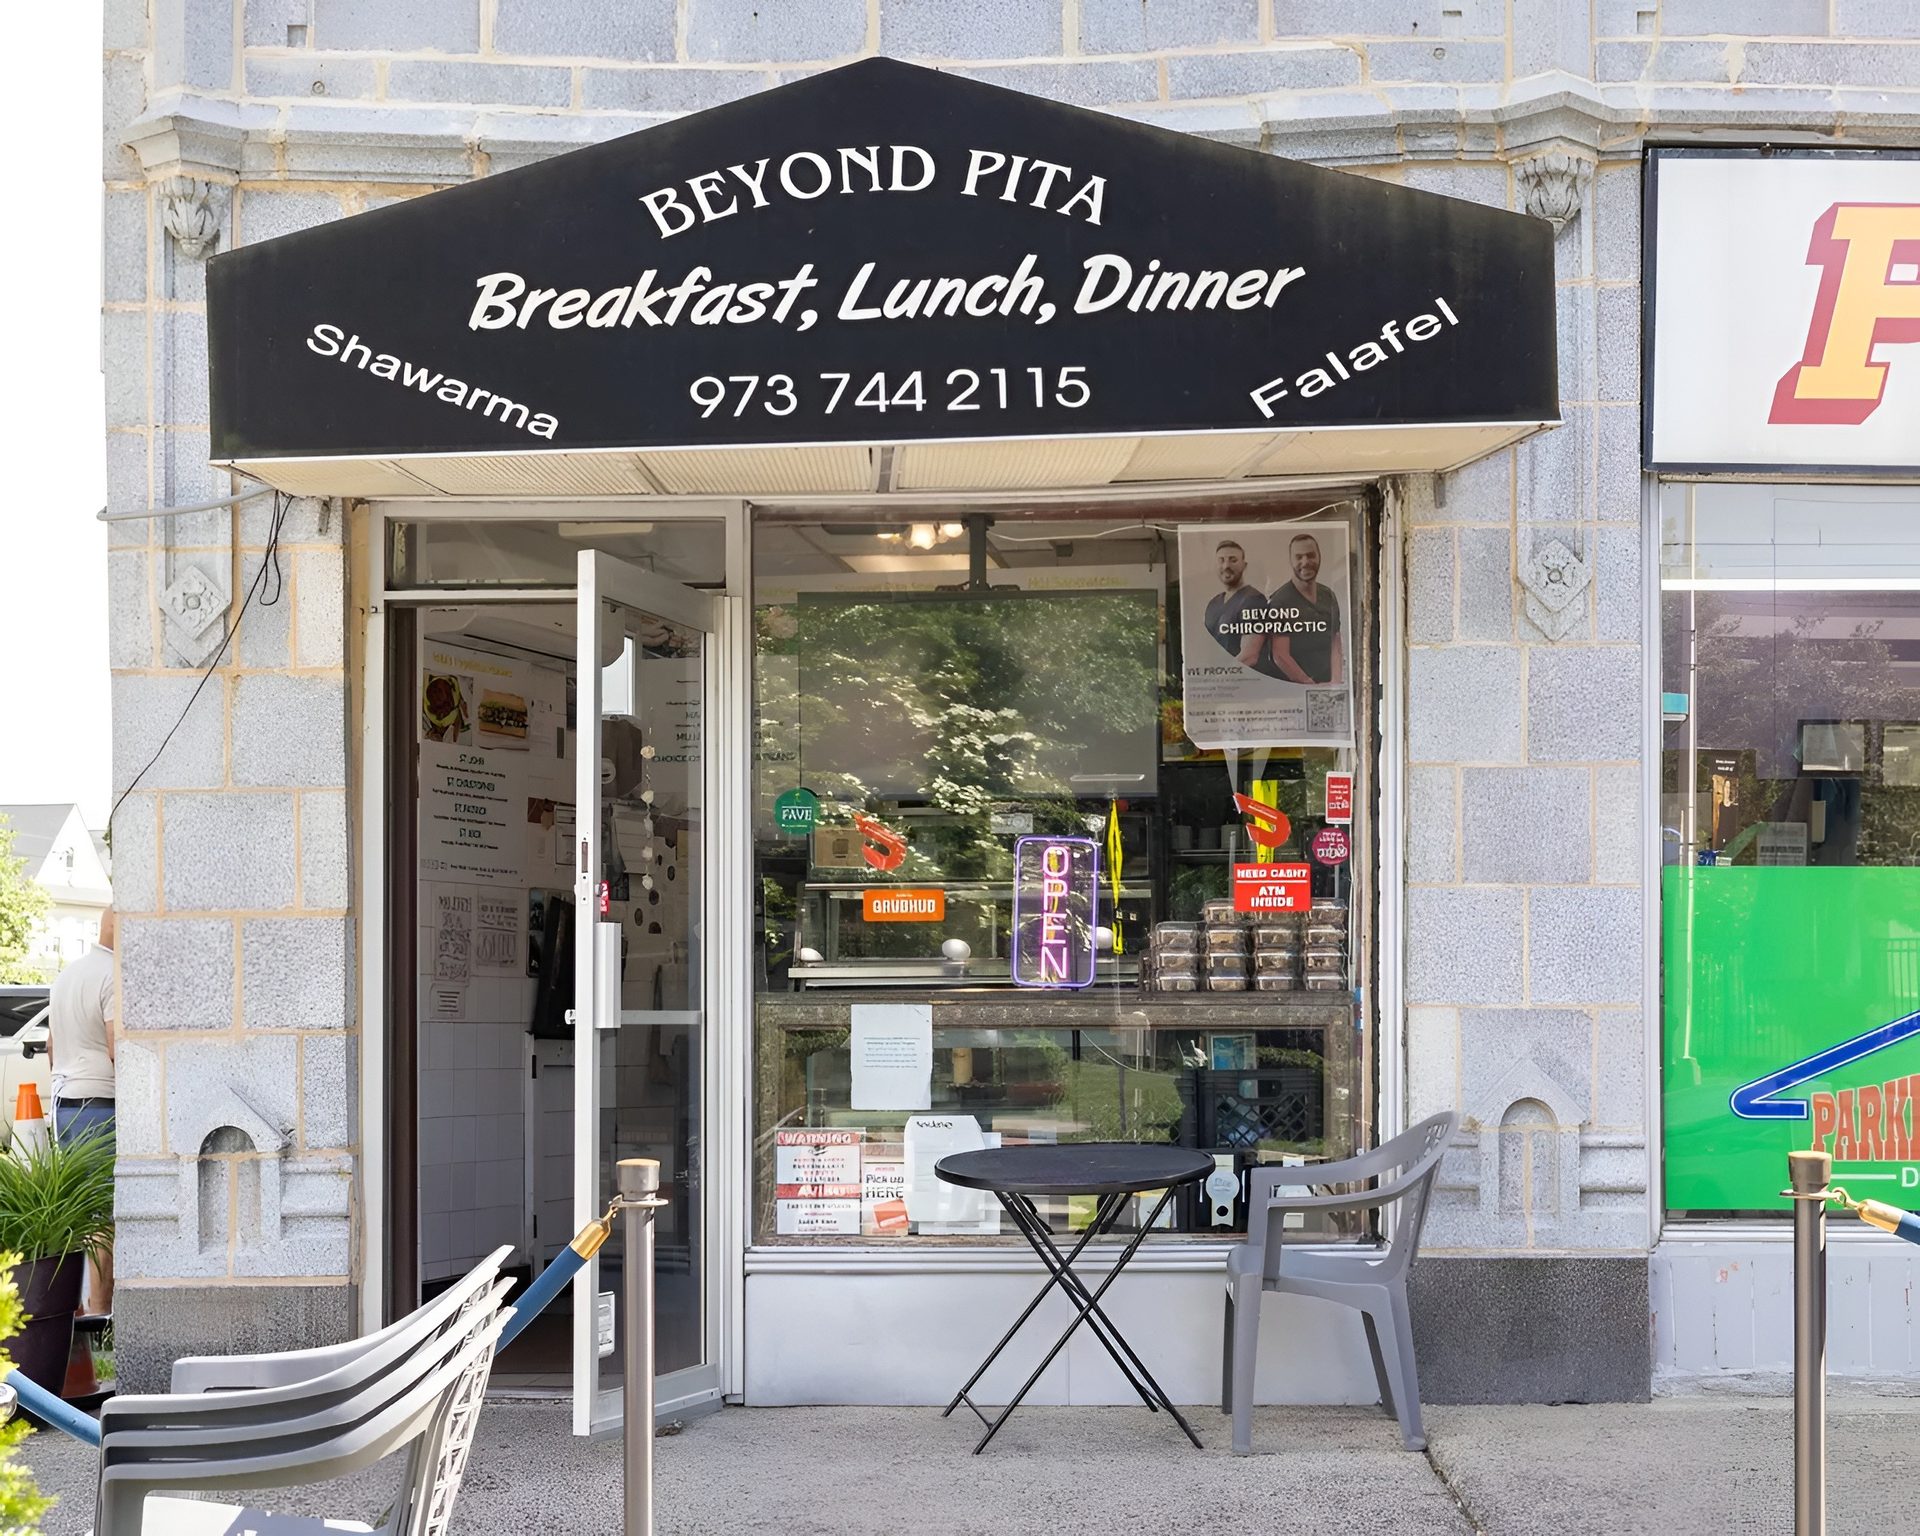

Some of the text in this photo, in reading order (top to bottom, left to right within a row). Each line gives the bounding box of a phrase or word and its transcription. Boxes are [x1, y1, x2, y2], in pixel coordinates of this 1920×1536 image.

[639, 145, 1108, 240] BEYOND PITA
[468, 253, 1306, 332] Breakfast, Lunch, Dinner
[306, 323, 559, 440] Shawarma
[1249, 296, 1460, 419] Falafel
[689, 366, 1091, 419] 973 744 2115
[1219, 621, 1327, 634] CHIROPRACTIC
[1241, 607, 1300, 620] BEYOND
[1237, 869, 1267, 879] NEED
[1259, 886, 1286, 896] ATM
[1040, 846, 1069, 979] OPEN
[1250, 897, 1294, 907] INSIDE
